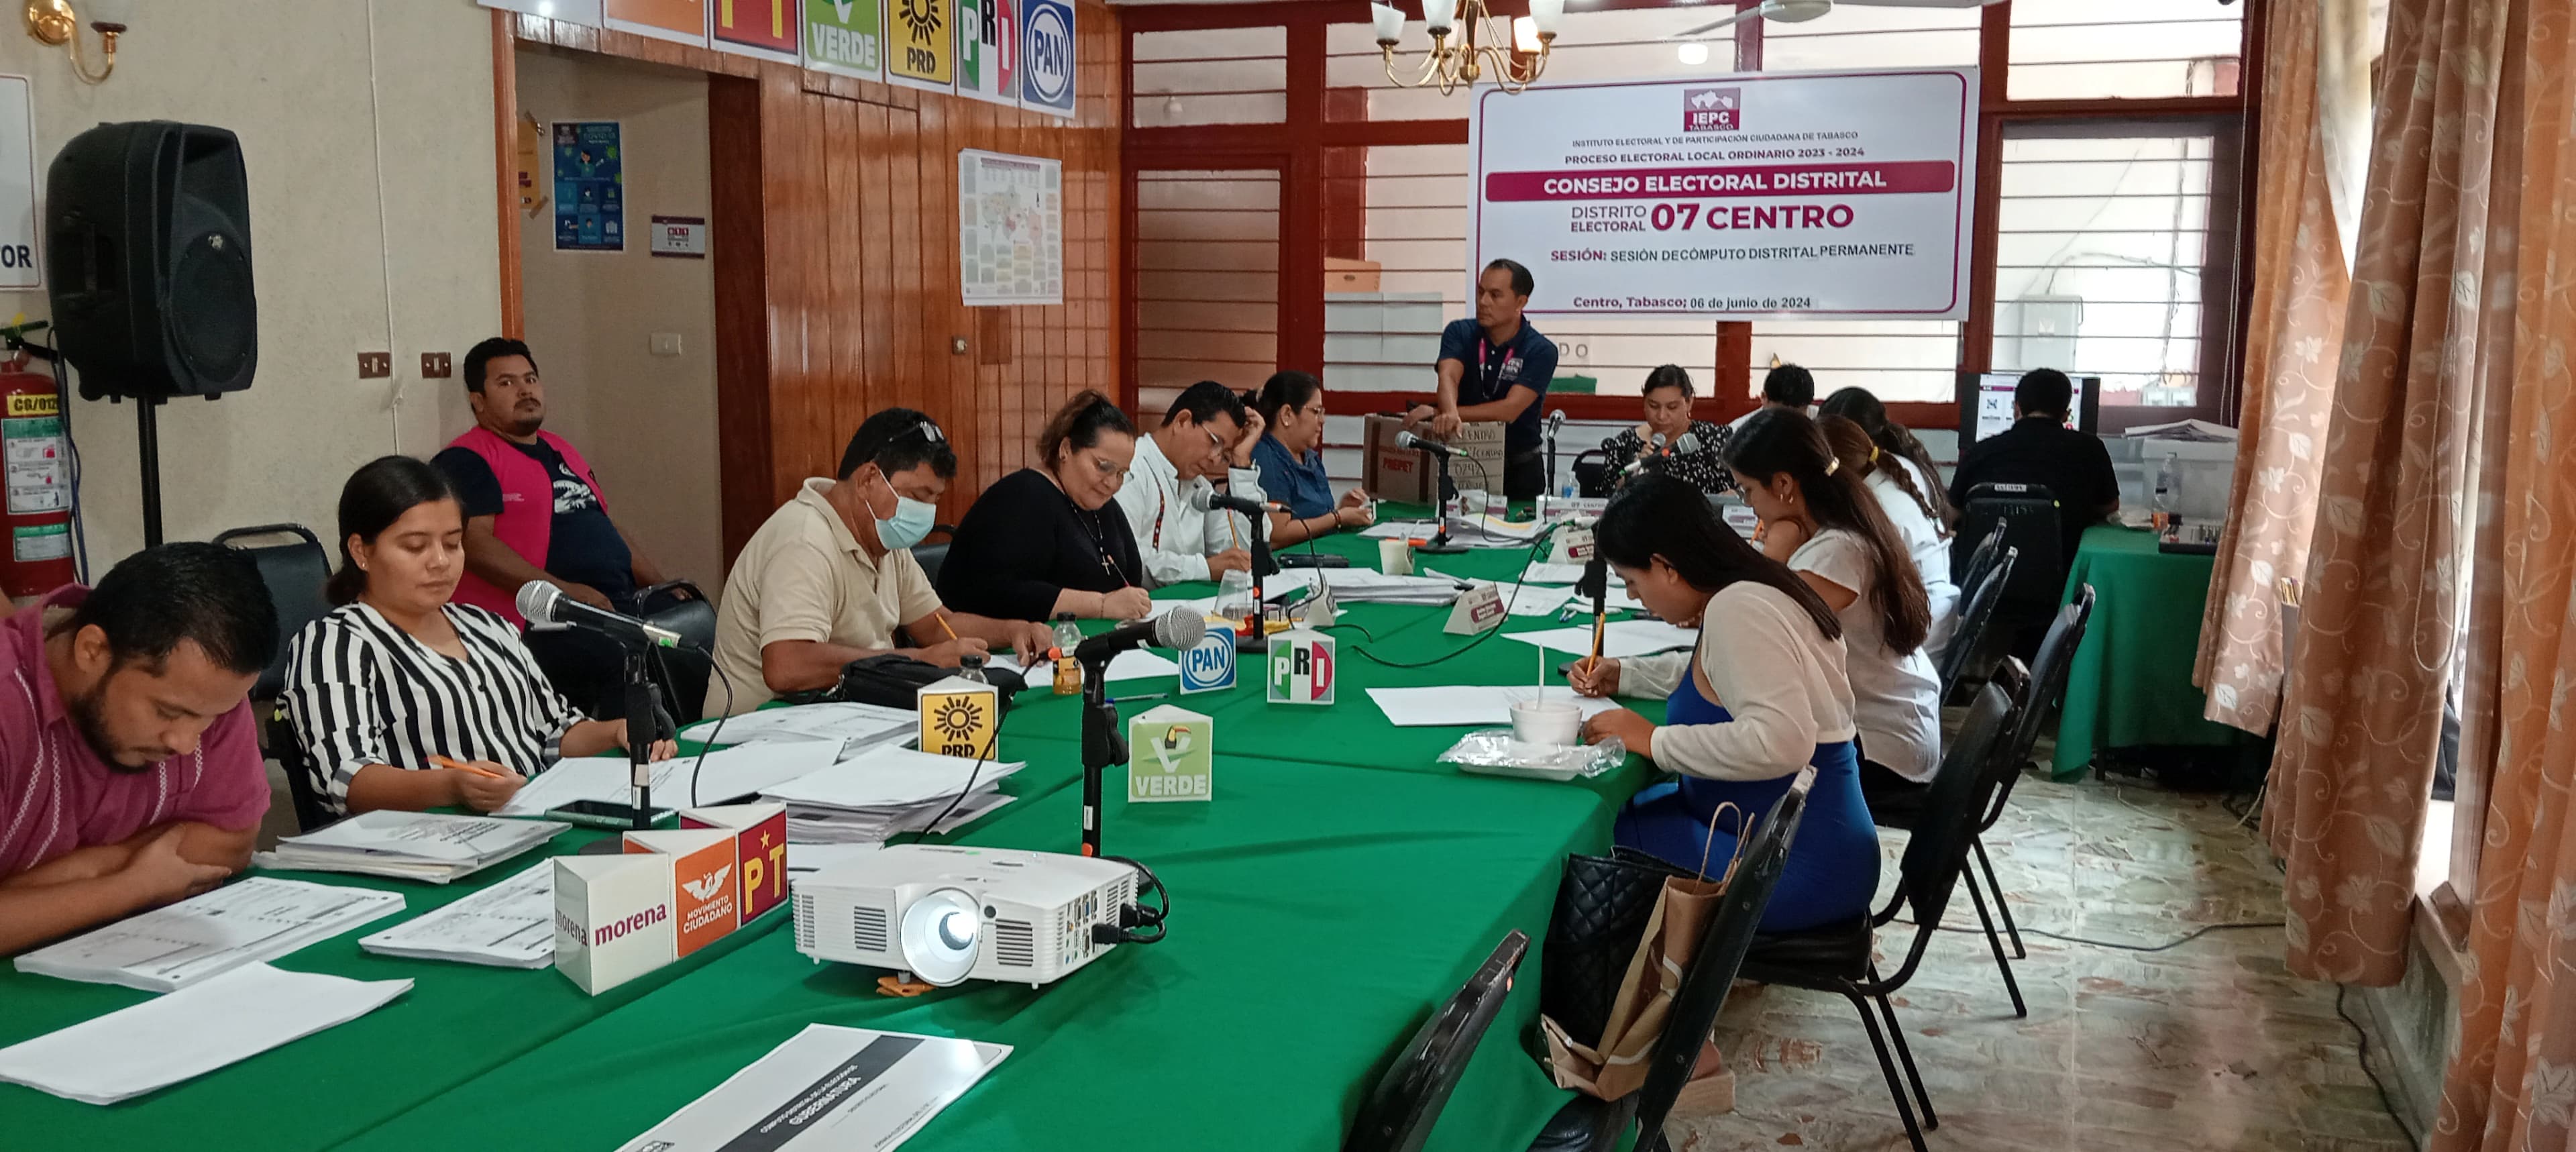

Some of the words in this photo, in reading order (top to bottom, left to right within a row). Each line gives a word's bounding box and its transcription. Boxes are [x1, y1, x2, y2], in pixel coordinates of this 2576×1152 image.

[811, 22, 875, 66] VERDE
[962, 0, 1010, 70] PRI
[906, 47, 936, 74] PRD
[1034, 29, 1064, 76] PAN
[1688, 123, 1734, 132] TABASCO
[1693, 111, 1729, 125] IEPC
[1572, 139, 1613, 148] INSTITUTO
[1615, 137, 1663, 146] ELECTORAL
[1672, 136, 1684, 144] DE
[1685, 133, 1748, 144] PARTICIPACIÓN
[1750, 132, 1801, 142] CIUDADANA
[1803, 132, 1815, 140] DE
[1817, 131, 1858, 140] TABASCO
[1565, 154, 1617, 165] PROCESO
[1620, 152, 1684, 163] ELECTORAL
[1687, 151, 1725, 161] LOCAL
[1728, 148, 1795, 160] ORDINARIO
[1798, 148, 1825, 158] 2023
[1835, 147, 1864, 156] 2024
[1544, 176, 1640, 195] CONSEJO
[1646, 173, 1768, 193] ELECTORAL
[1773, 170, 1888, 191] DISTRITAL
[1571, 205, 1646, 219] DISTRITO
[1651, 203, 1700, 231] 07
[1706, 203, 1854, 230] CENTRO
[1570, 221, 1646, 233] ELECTORAL
[0, 244, 33, 268] OR
[1550, 248, 1607, 261] SESIÓN:
[1610, 248, 1658, 262] SESIÓN
[1749, 246, 1817, 260] DISTRITAL
[1820, 244, 1914, 256] PERMANENTE
[1573, 296, 1622, 309] Centro,
[1690, 299, 1704, 308] 06
[1708, 298, 1723, 308] de
[1725, 297, 1758, 310] junio
[1762, 298, 1777, 308] de
[1781, 297, 1811, 308] 2024
[1191, 645, 1226, 672] PAN
[1273, 646, 1326, 687] PRI
[941, 743, 976, 757] PRD
[1134, 774, 1207, 797] VERDE
[743, 843, 785, 915] PT
[683, 902, 733, 935] CIUDADANO
[686, 894, 729, 921] MOVIMIENTO
[555, 908, 588, 947] morena
[594, 902, 667, 947] morena
